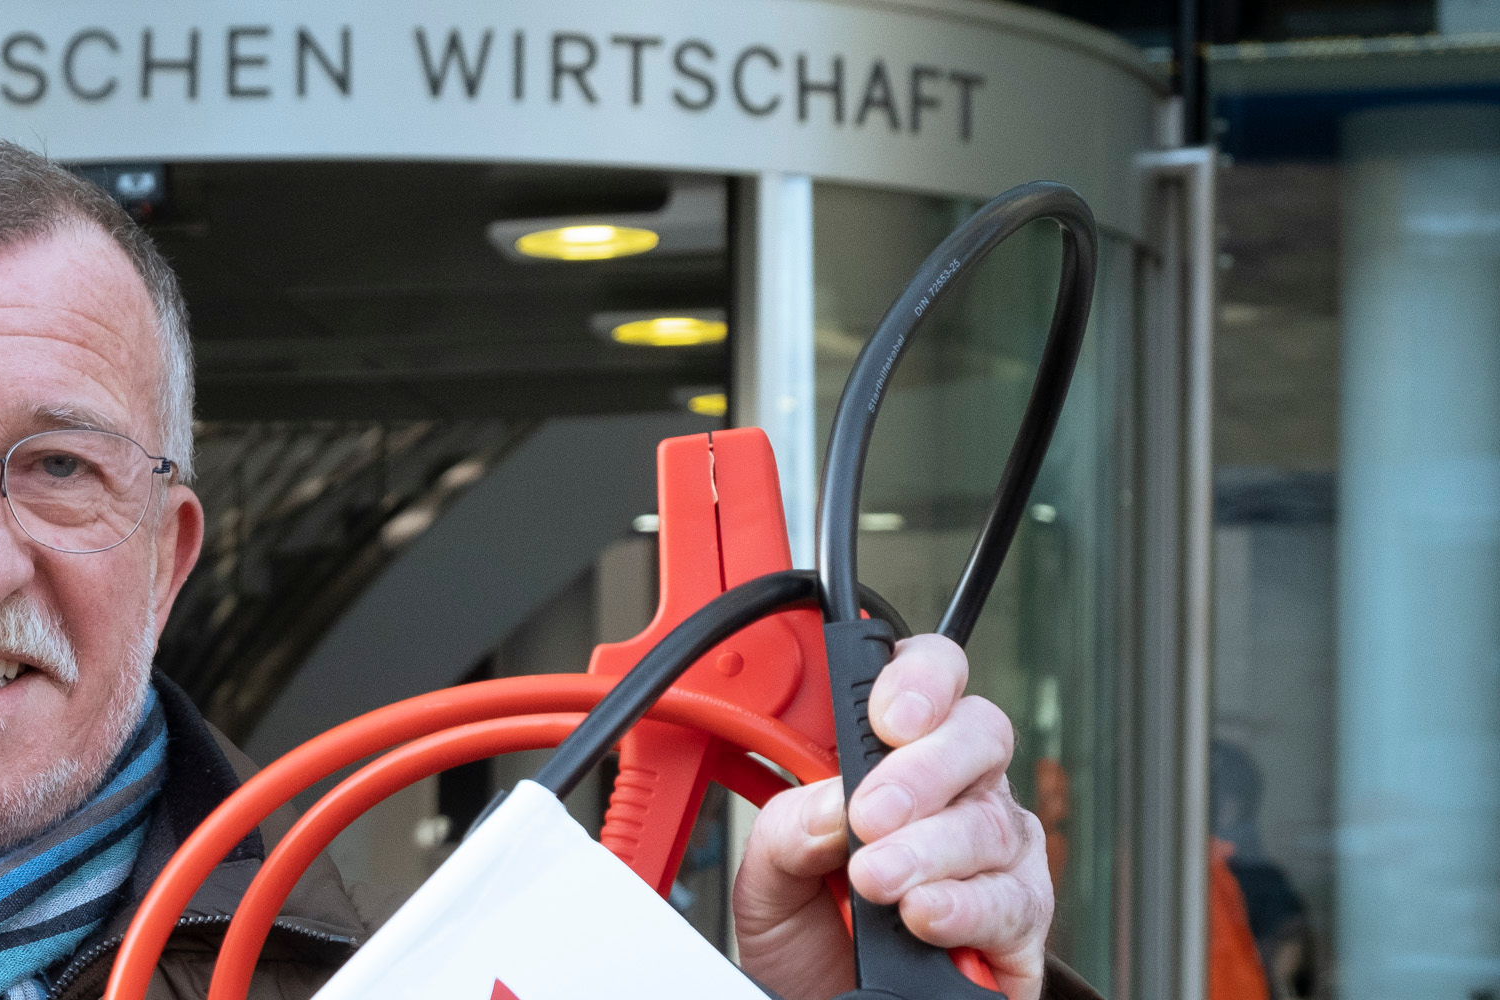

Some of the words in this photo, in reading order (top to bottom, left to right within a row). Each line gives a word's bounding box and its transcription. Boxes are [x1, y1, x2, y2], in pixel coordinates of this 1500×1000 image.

[414, 24, 987, 143] WIRTSCHAFT
[914, 296, 930, 317] DIN
[928, 258, 961, 297] 72553-25
